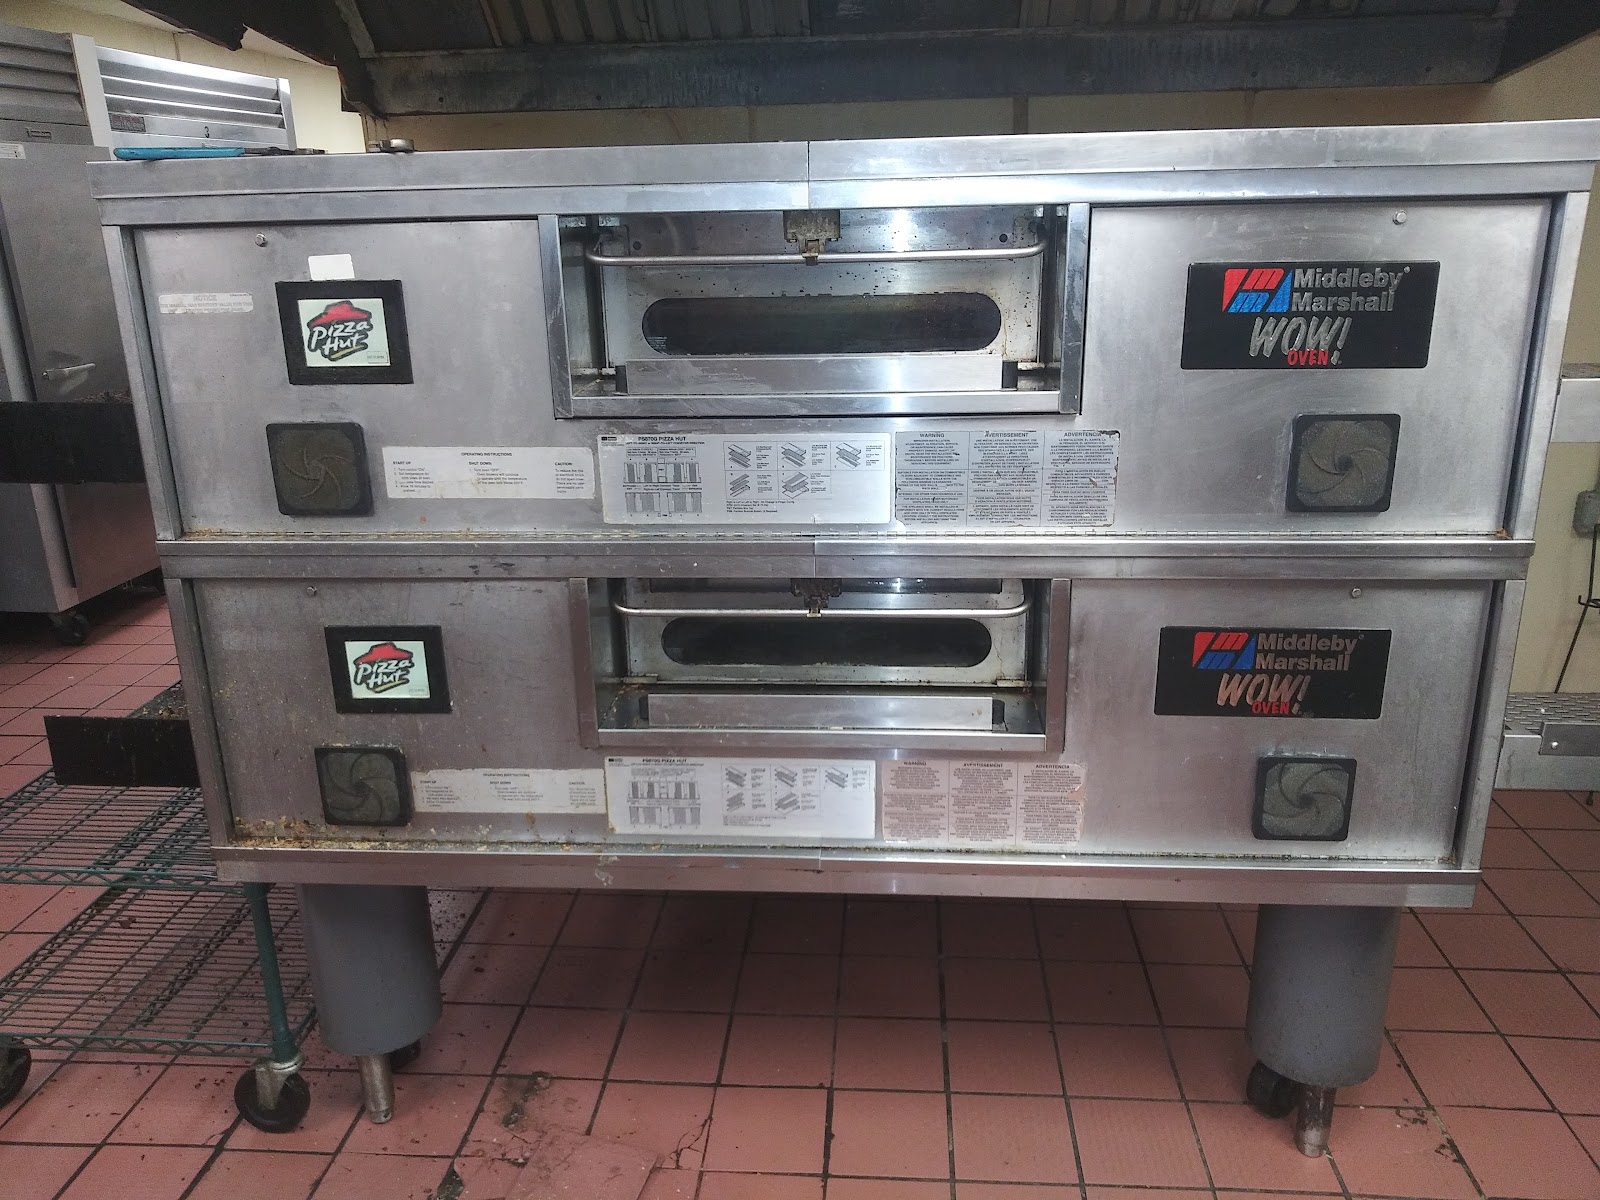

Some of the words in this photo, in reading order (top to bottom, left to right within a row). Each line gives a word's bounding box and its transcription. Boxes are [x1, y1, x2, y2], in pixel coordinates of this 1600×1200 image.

[1294, 268, 1404, 292] Middleby
[1291, 291, 1395, 312] Marshall
[311, 320, 370, 351] Pizza
[324, 335, 366, 355] Hut
[1249, 316, 1352, 366] WOW!
[1287, 349, 1329, 366] OVEN
[1258, 633, 1358, 655] Middleby
[356, 660, 412, 684] Pizza
[1255, 652, 1350, 671] Marshall
[368, 670, 406, 688] Hut
[1216, 672, 1312, 714] WOW!
[1252, 700, 1290, 714] OVEN
